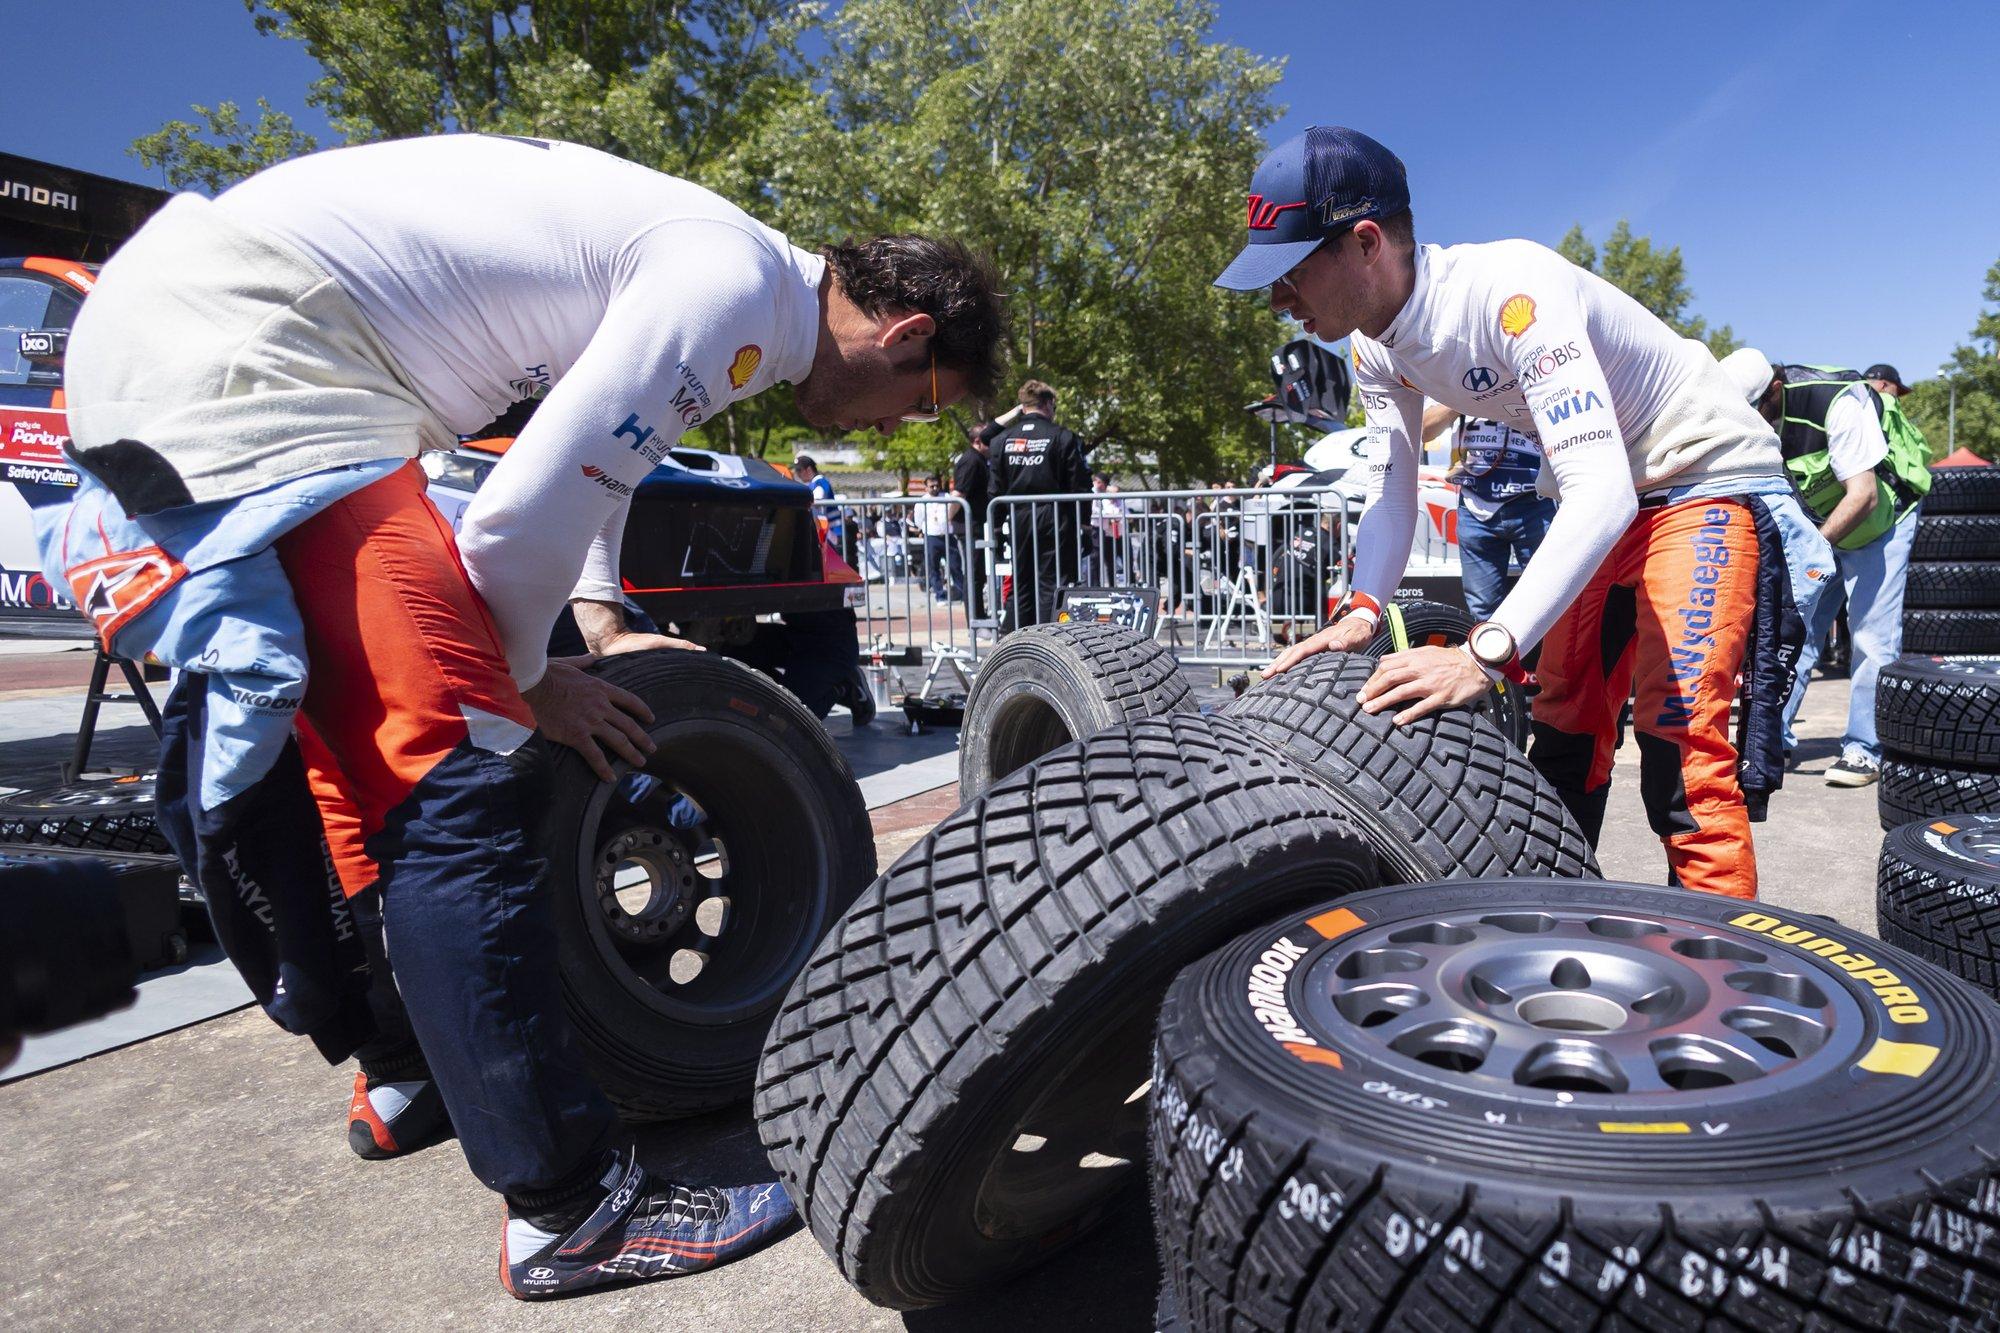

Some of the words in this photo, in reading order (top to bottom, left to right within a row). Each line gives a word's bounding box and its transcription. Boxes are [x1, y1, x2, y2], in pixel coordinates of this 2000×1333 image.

[1523, 342, 1581, 387] MOBIS
[675, 361, 711, 407] HYUNDAI
[1531, 387, 1571, 416] HYUNDAI
[8, 466, 78, 483] SafetyCulture
[1009, 455, 1044, 466] DENSO
[1656, 508, 1731, 727] M.Wydaeghe
